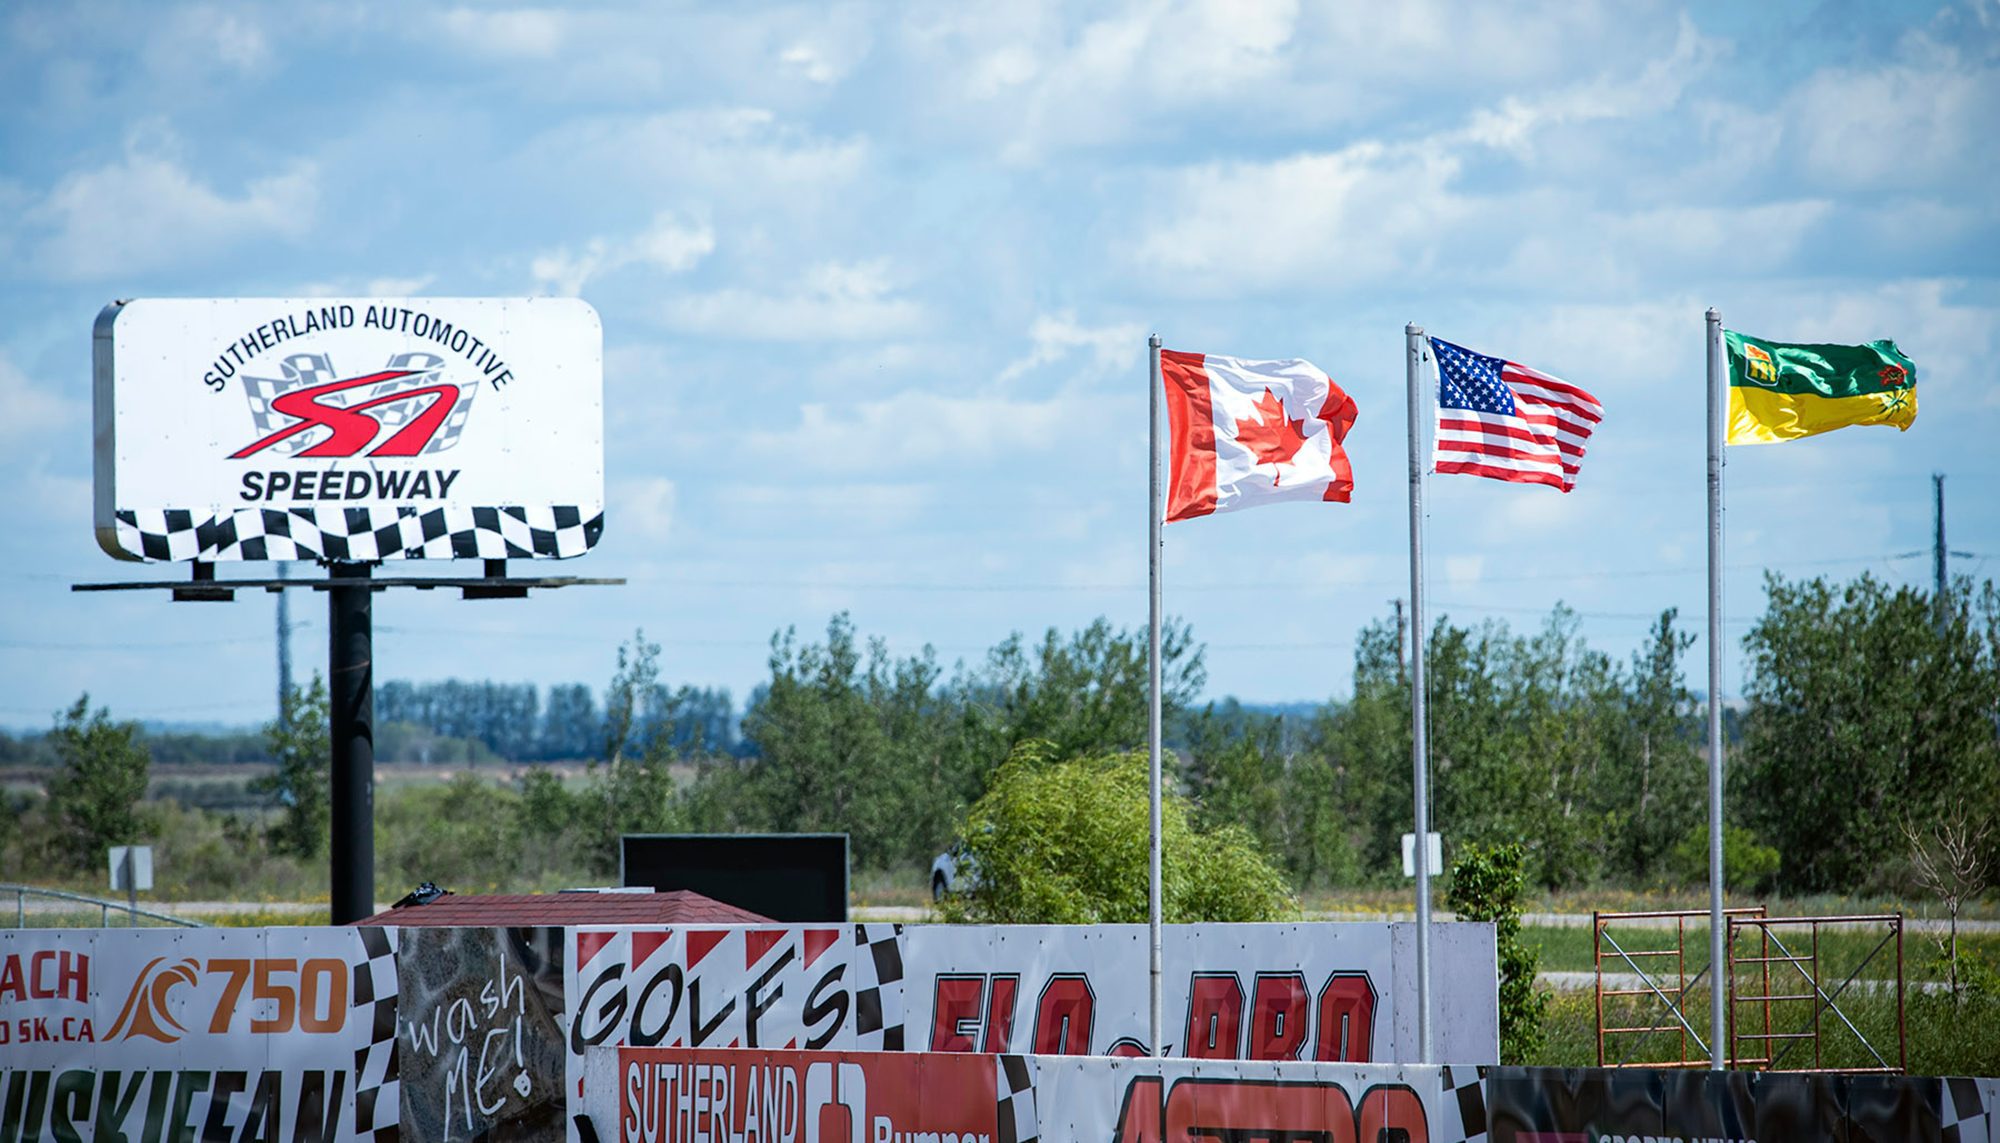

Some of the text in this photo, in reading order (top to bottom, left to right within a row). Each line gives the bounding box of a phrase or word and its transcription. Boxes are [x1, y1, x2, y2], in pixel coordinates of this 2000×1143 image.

[204, 305, 514, 393] SUTHERLAND AUTOMOTIVE
[240, 469, 460, 501] SPEEDWAY
[206, 958, 348, 1034] 750
[409, 953, 525, 1056] wash
[625, 1061, 798, 1143] SUTHERLAND
